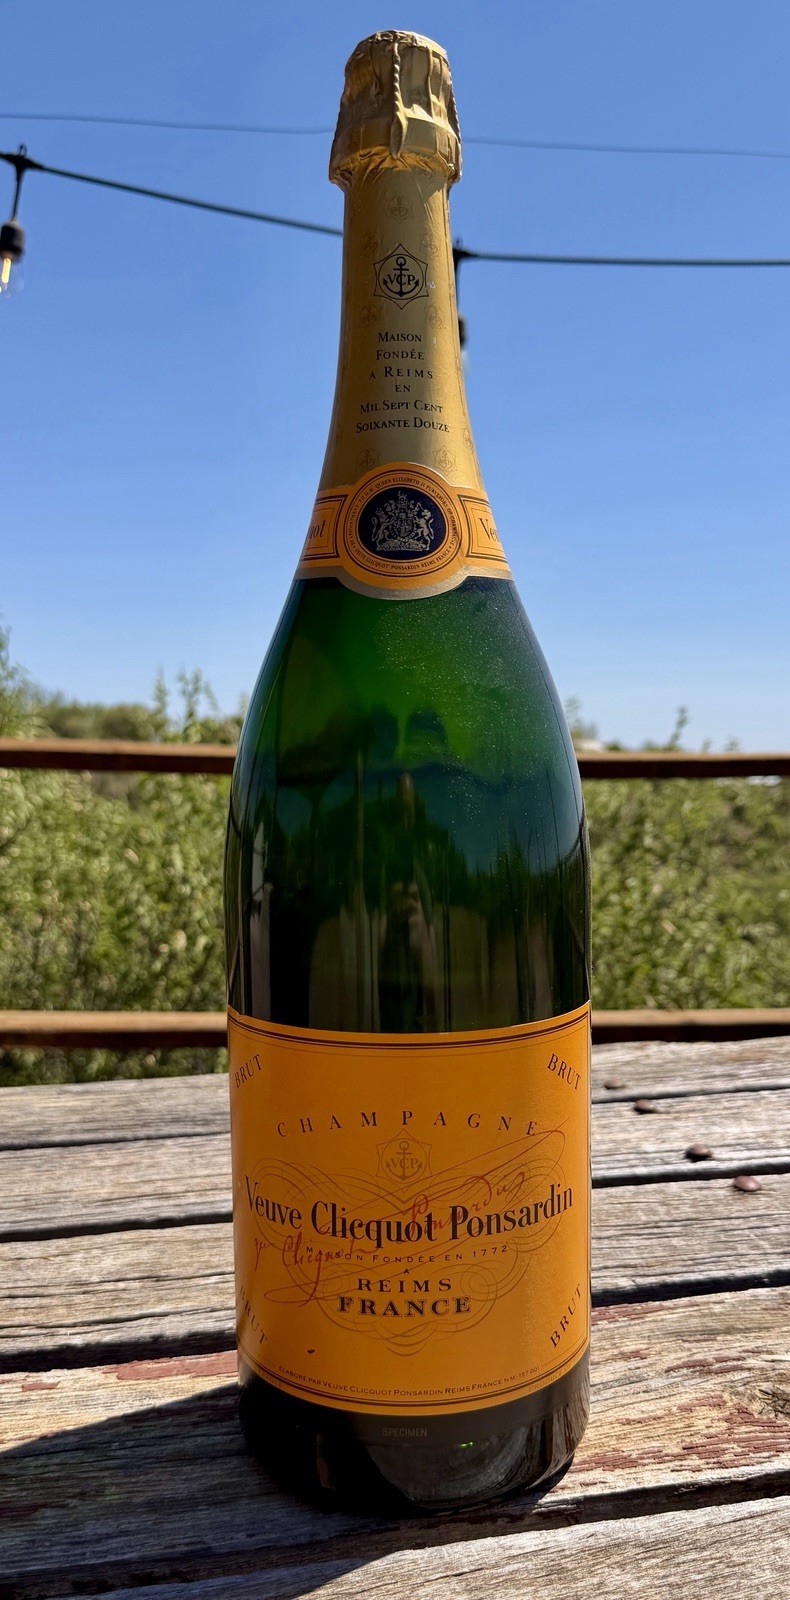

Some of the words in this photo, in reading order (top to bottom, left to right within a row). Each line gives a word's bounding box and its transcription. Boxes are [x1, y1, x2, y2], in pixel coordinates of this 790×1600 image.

[387, 273, 415, 286] VCP
[378, 331, 422, 342] MAISON
[376, 349, 424, 361] FONDÉE
[369, 371, 376, 380] A
[384, 366, 433, 379] REIMS
[395, 384, 411, 393] EN
[360, 402, 380, 415] MIL
[383, 400, 410, 411] SEPT
[414, 400, 443, 414] CENT
[356, 419, 410, 434] SOIXANTE
[414, 417, 450, 433] DOUZE
[233, 1053, 263, 1089] BRUT
[547, 1053, 581, 1090] BRUT
[277, 1110, 538, 1138] CHAMPAGNE
[390, 1157, 419, 1169] VCP
[244, 1174, 302, 1230] Veuve
[311, 1200, 438, 1249] Clicquot
[449, 1183, 573, 1241] Ponsardin
[306, 1246, 363, 1261] MAISON
[372, 1253, 435, 1263] FONDÉE
[445, 1253, 463, 1261] EN
[473, 1245, 507, 1258] 1772
[357, 1278, 452, 1293] REIMS
[337, 1295, 471, 1317] FRANCE
[549, 1283, 581, 1348] BRUT
[308, 1377, 321, 1385] PAR
[322, 1381, 349, 1391] VEUVE
[350, 1385, 392, 1396] CLICQUOT
[444, 1385, 470, 1394] REIMS
[471, 1378, 503, 1390] FRANCE
[383, 1427, 428, 1438] SPECIMEN
